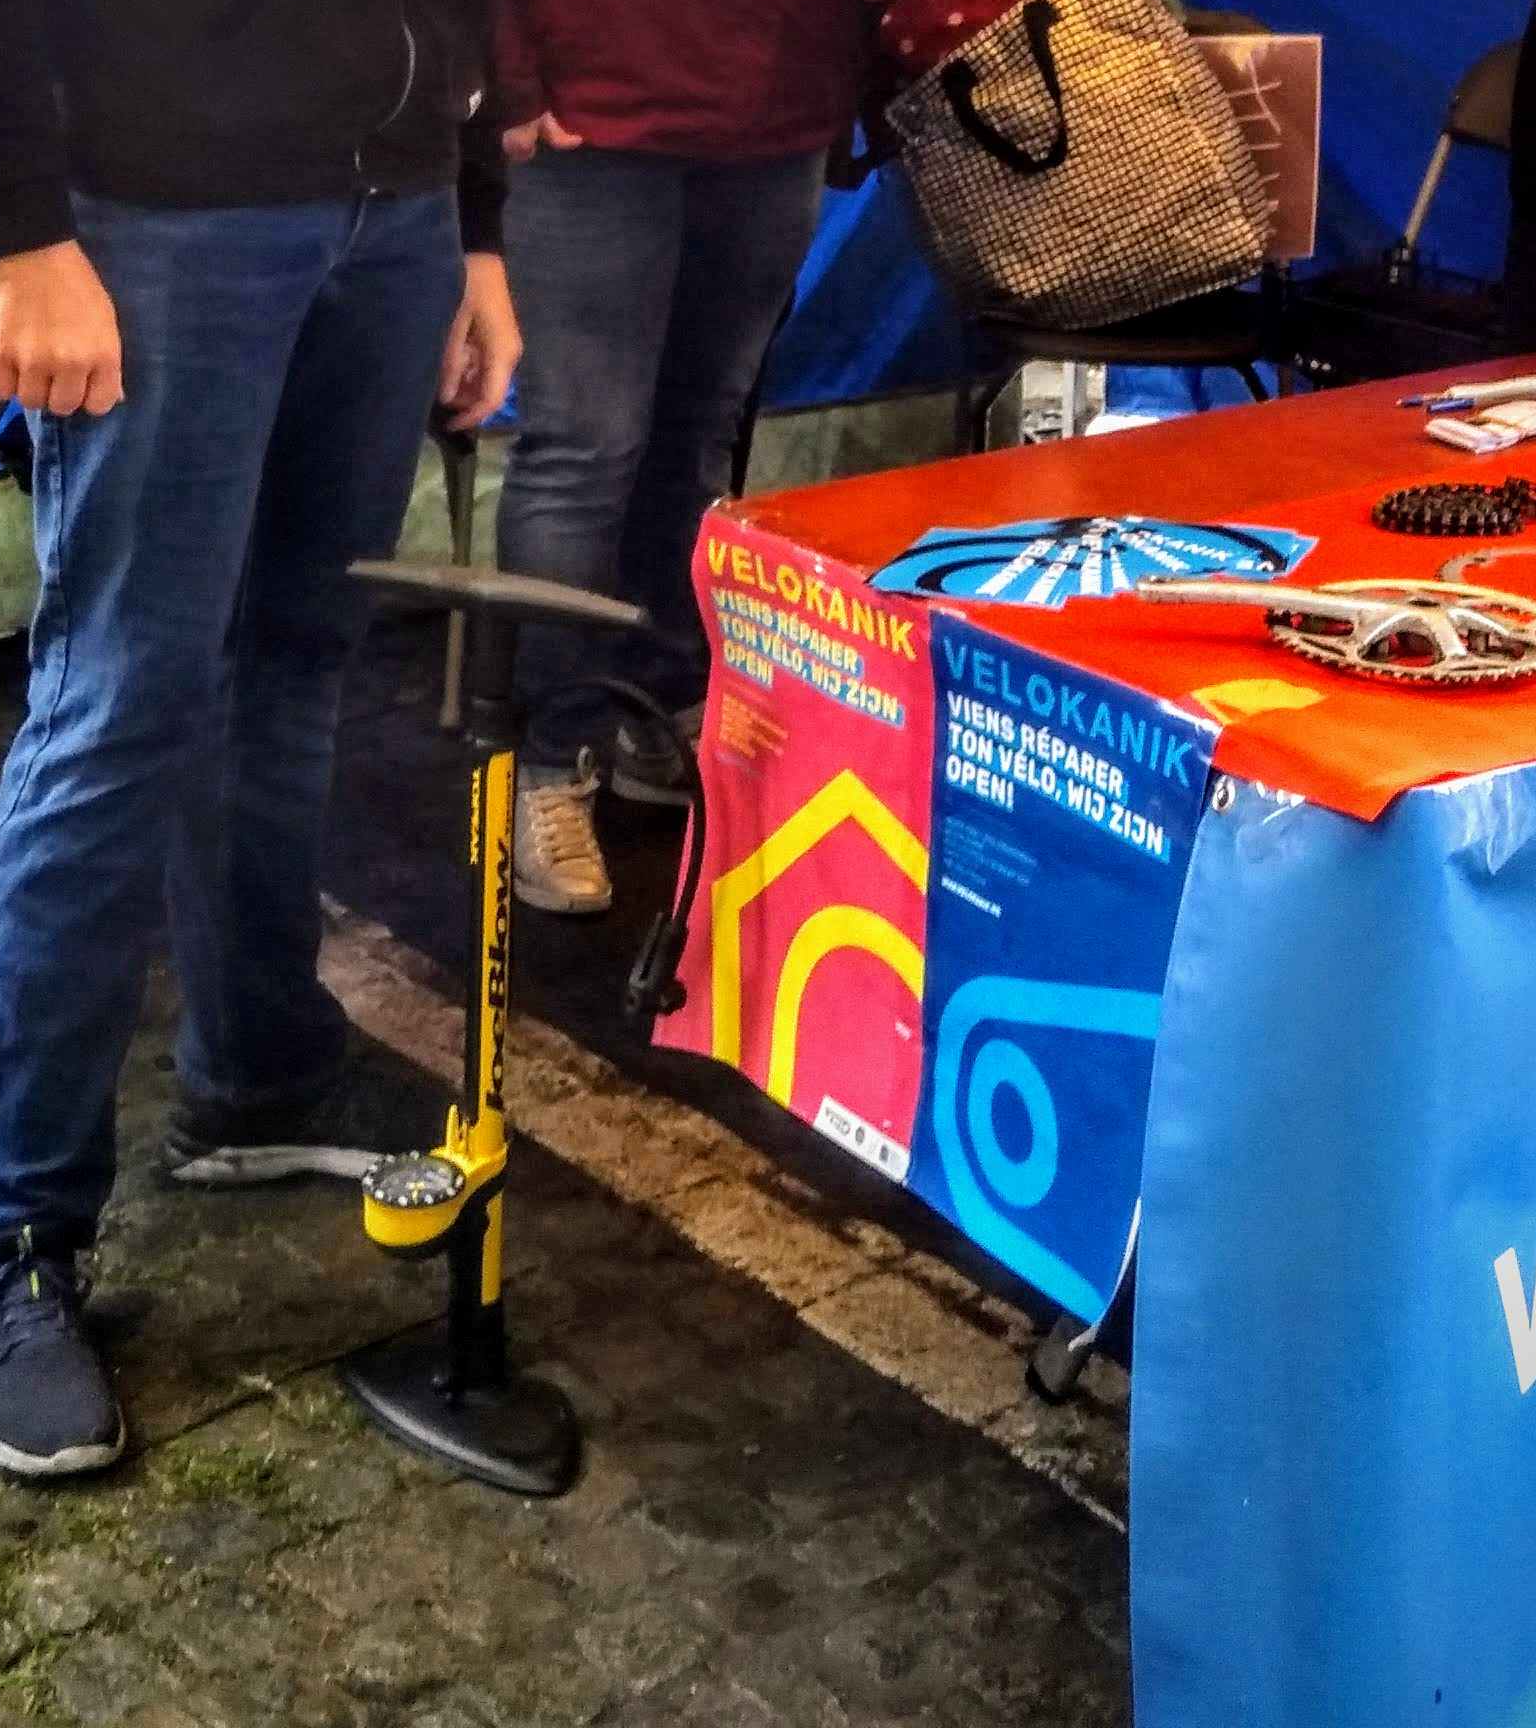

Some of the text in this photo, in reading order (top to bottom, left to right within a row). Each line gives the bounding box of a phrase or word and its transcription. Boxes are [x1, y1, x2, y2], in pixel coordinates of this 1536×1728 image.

[707, 538, 917, 661] VELOKANIK
[943, 636, 1192, 788] VELOKANIK
[947, 690, 1124, 799] VIENS RÉPARER
[948, 722, 1164, 855] TON VÉLO, WIJ ZIJN
